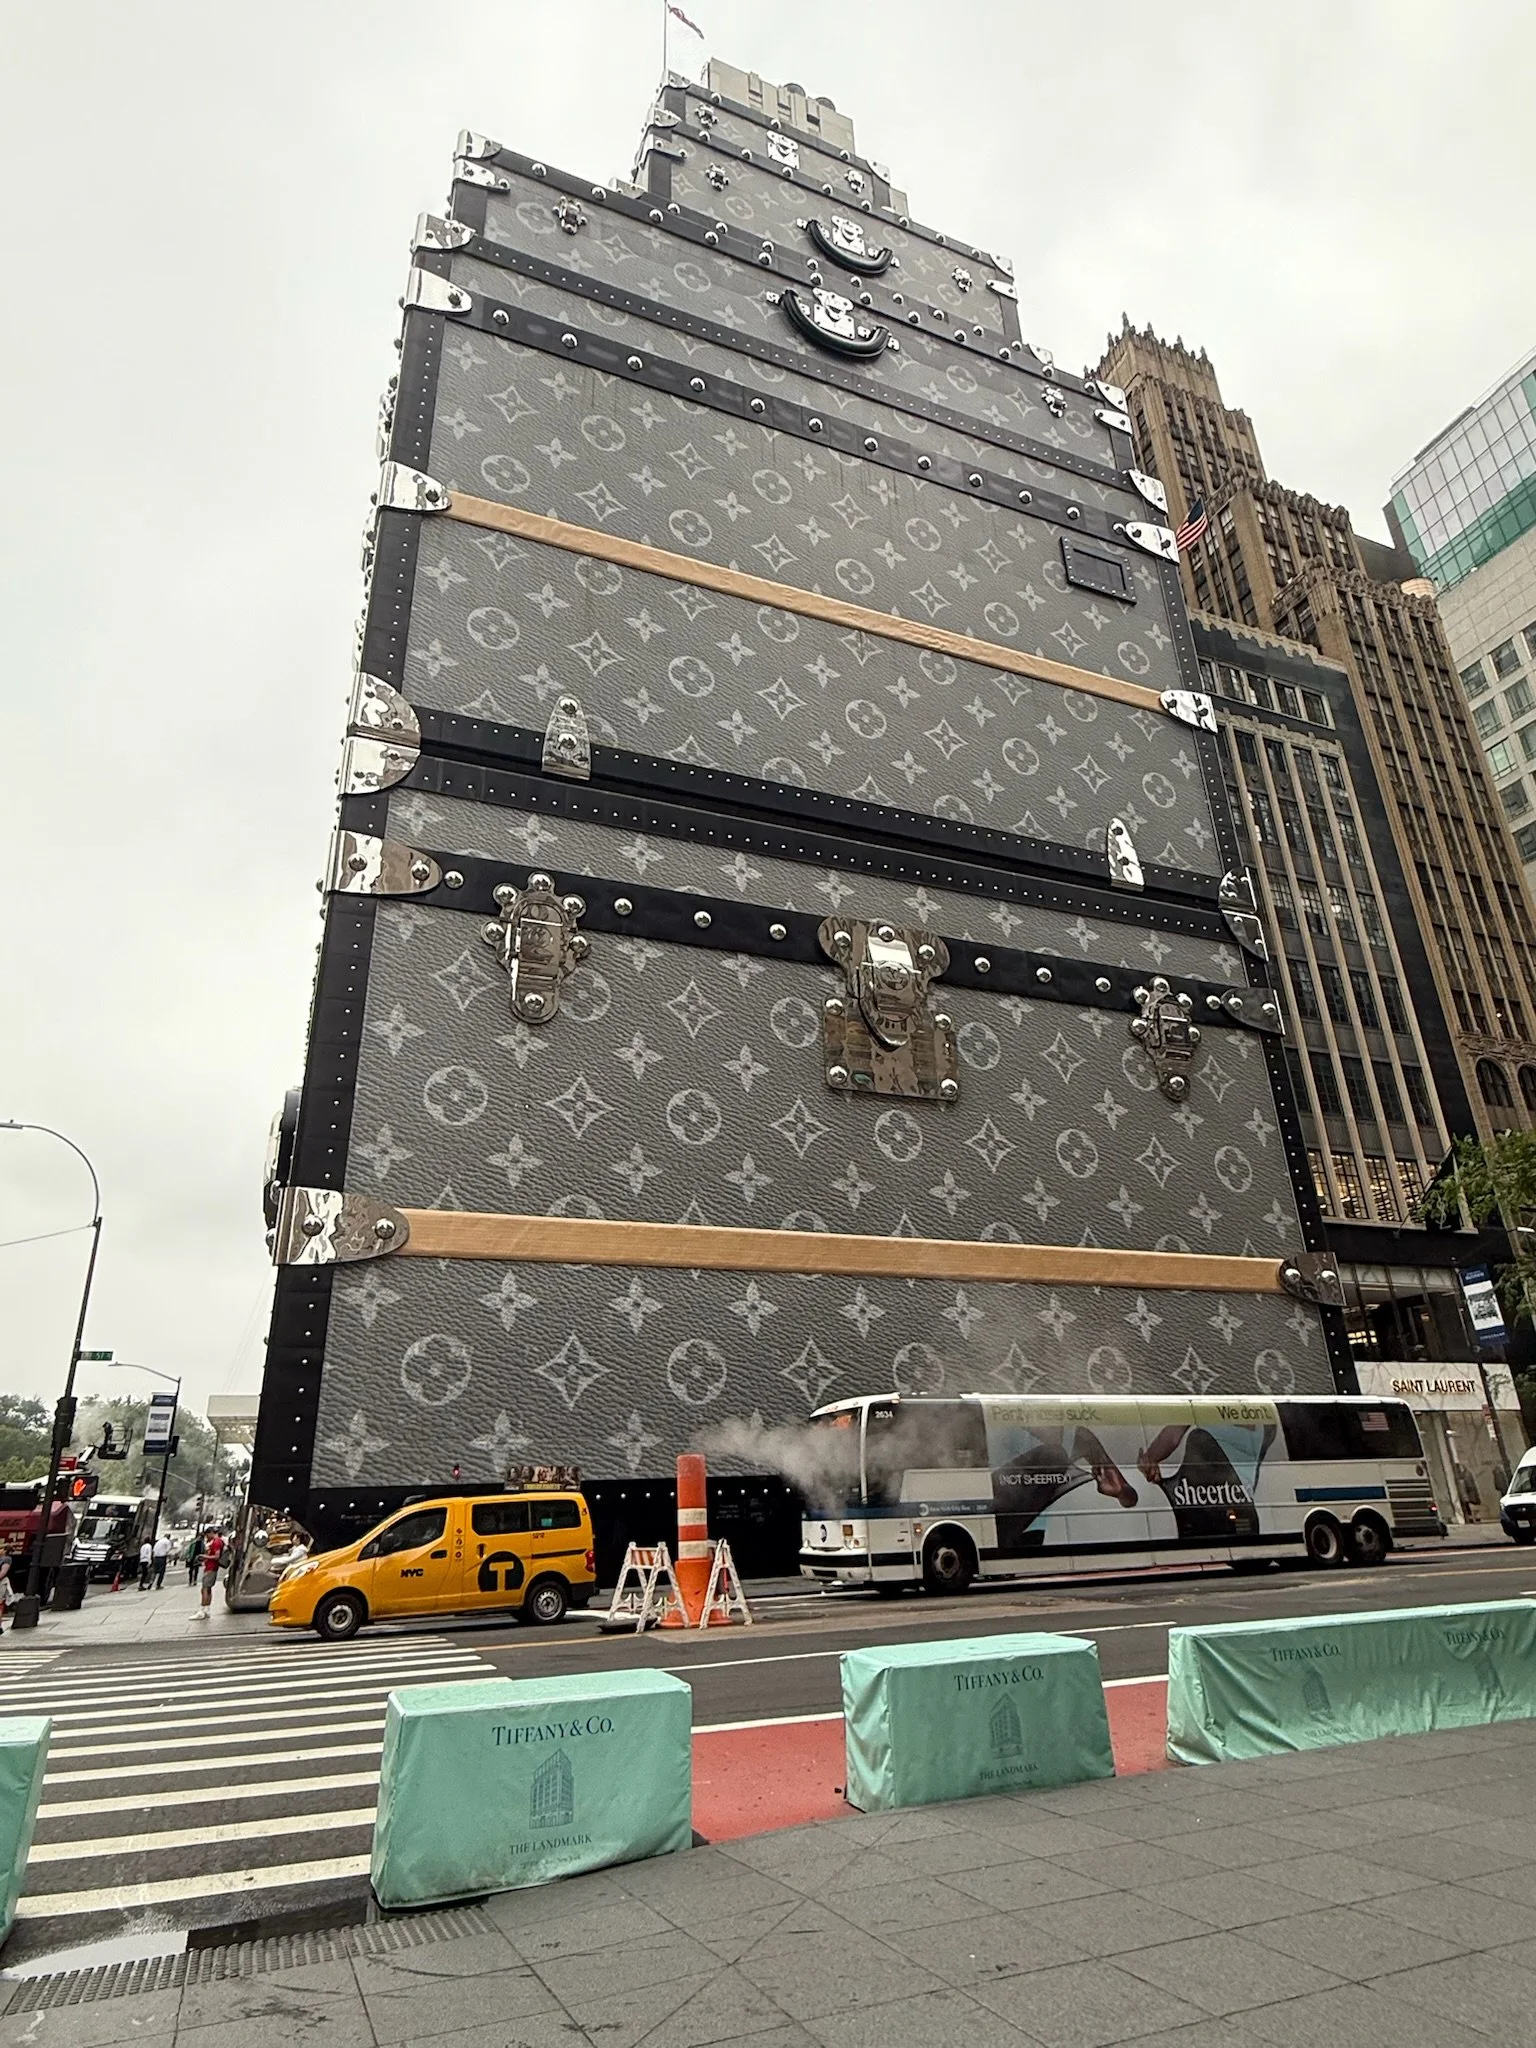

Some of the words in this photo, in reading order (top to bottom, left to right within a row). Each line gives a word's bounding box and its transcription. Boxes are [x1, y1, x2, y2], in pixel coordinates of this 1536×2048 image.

[1392, 1380, 1424, 1393] SAINT
[1426, 1380, 1475, 1393] LAURENT
[1216, 1406, 1239, 1419] We
[1174, 1478, 1253, 1506] sheertex
[400, 1568, 424, 1578] NYC
[489, 1561, 514, 1592] T
[980, 1770, 994, 1781] THE
[995, 1761, 1039, 1778] LANDMARK
[509, 1842, 530, 1856] THE
[532, 1833, 592, 1852] LANDMARK
